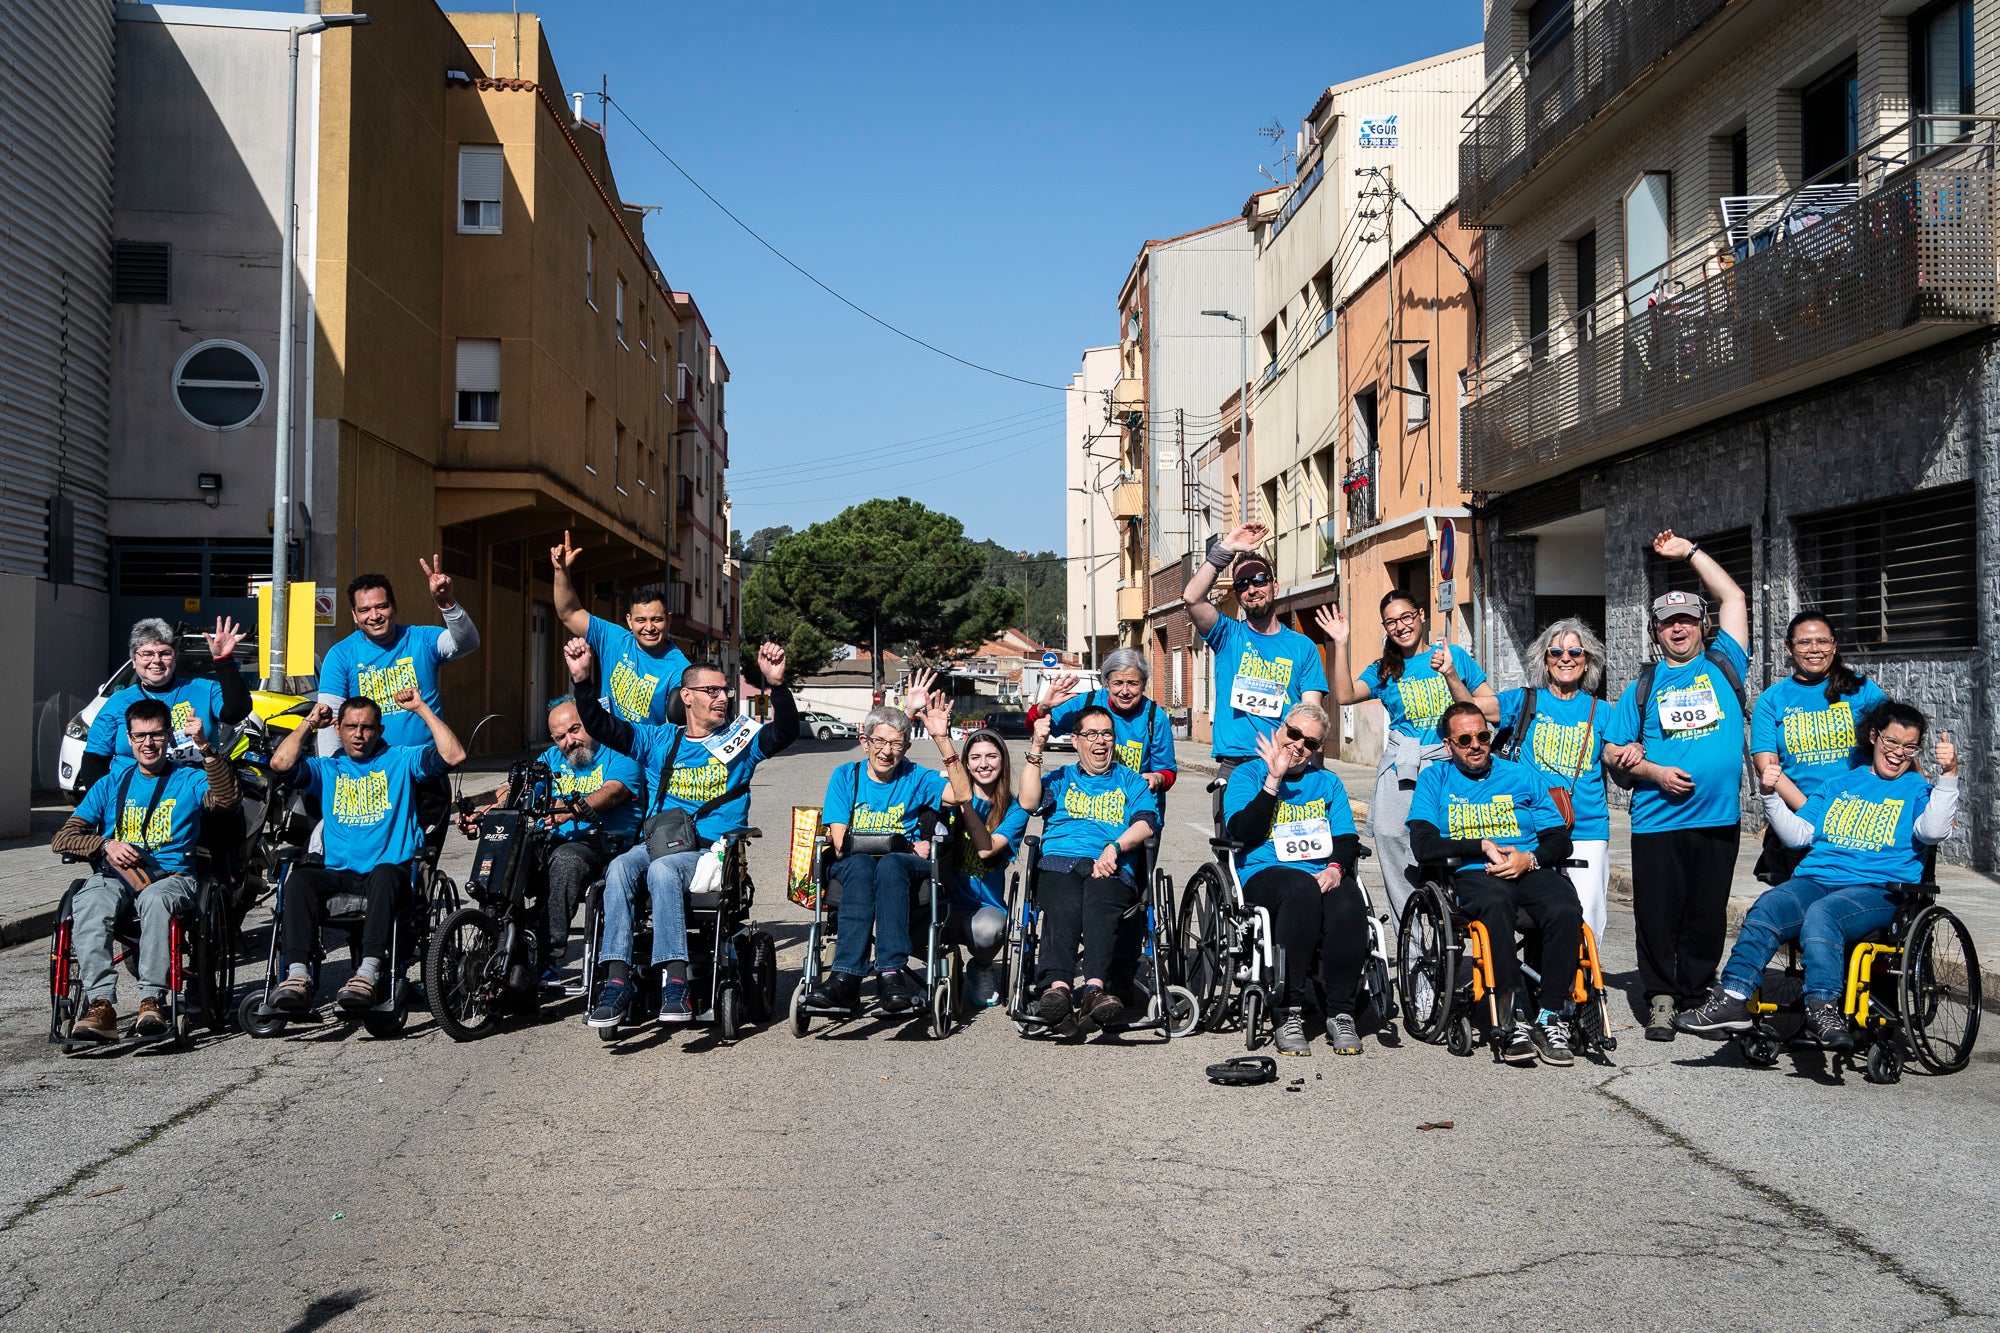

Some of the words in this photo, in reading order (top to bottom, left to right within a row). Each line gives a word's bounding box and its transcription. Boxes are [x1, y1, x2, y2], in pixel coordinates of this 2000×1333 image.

[1237, 693, 1278, 710] 1244
[1671, 709, 1706, 722] 808
[1783, 707, 1851, 724] PARKINSON
[724, 728, 750, 755] 829
[1796, 752, 1849, 763] PARKINSON
[1286, 839, 1322, 853] 806
